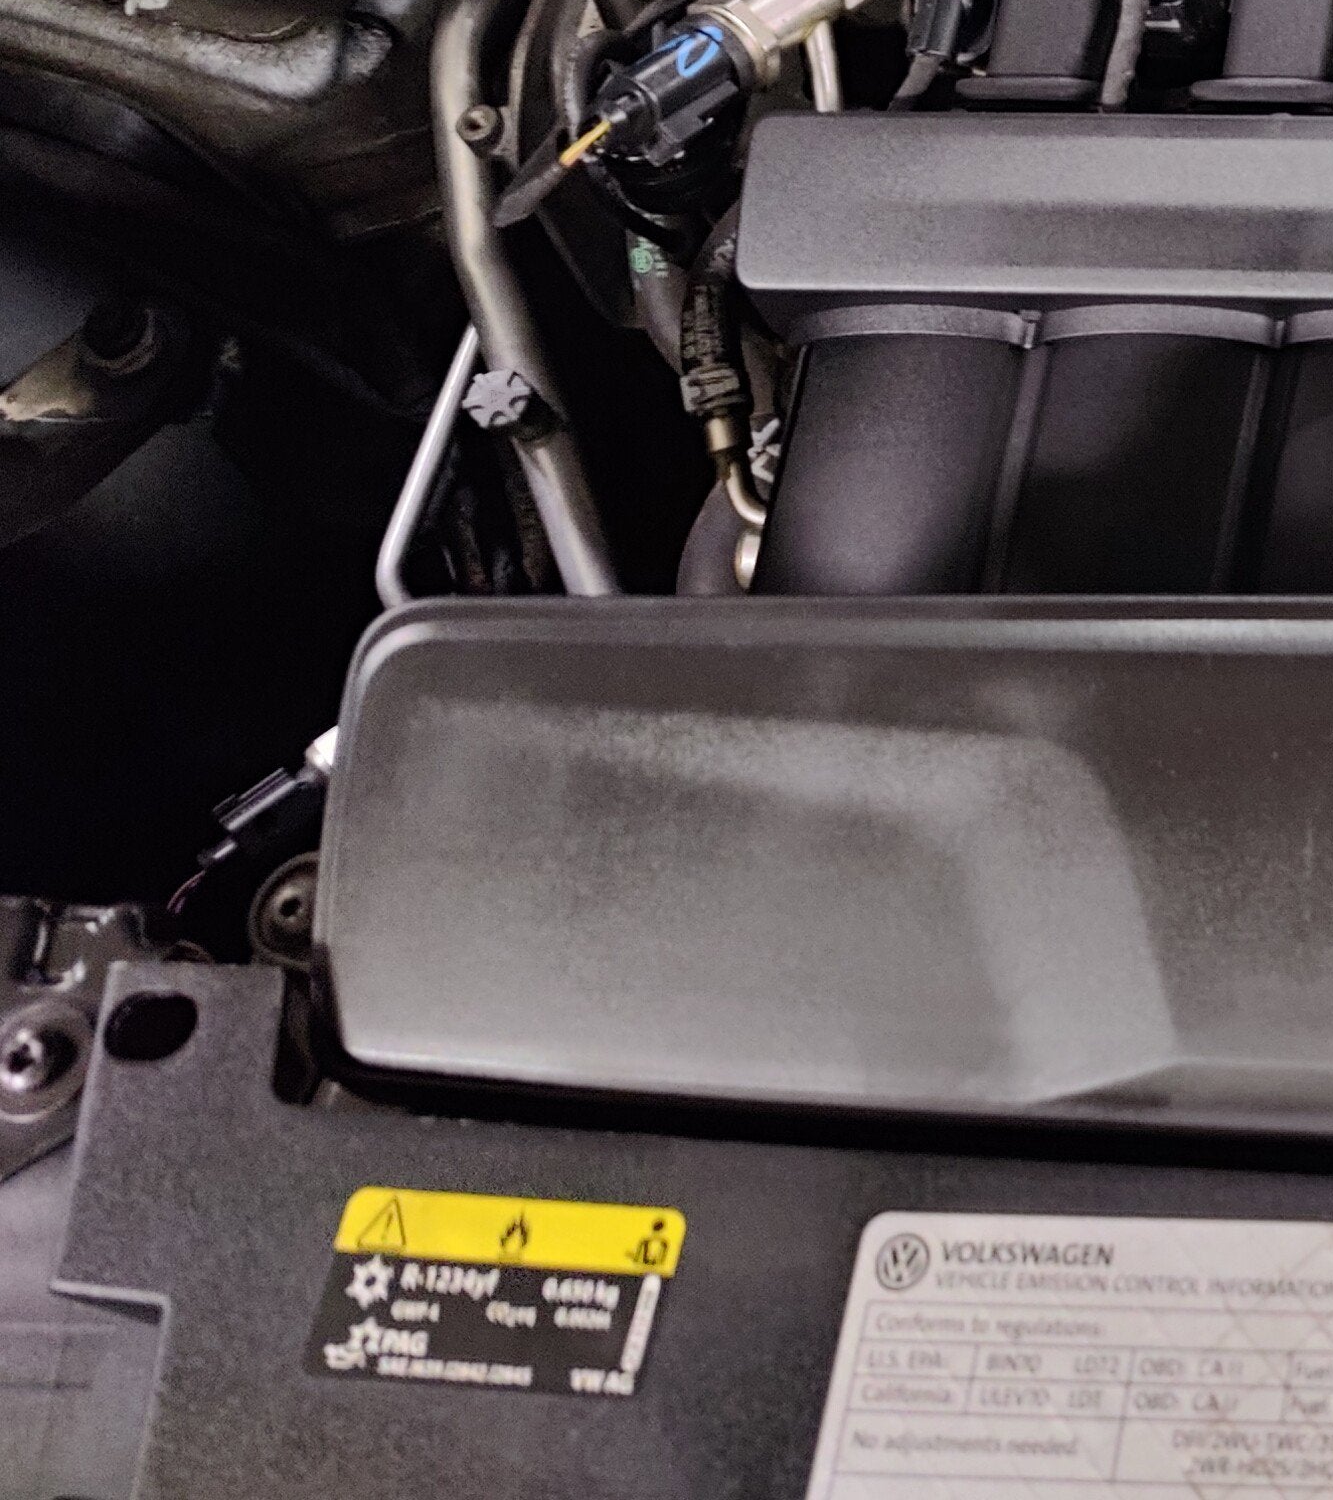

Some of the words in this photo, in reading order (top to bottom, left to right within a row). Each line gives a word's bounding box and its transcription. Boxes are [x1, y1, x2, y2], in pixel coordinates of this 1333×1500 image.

[943, 1240, 1114, 1267] VOLKSWAGEN
[934, 1272, 1010, 1290] VEHICLE
[1015, 1273, 1106, 1293] EMISSION
[1112, 1275, 1198, 1295] CONTROL
